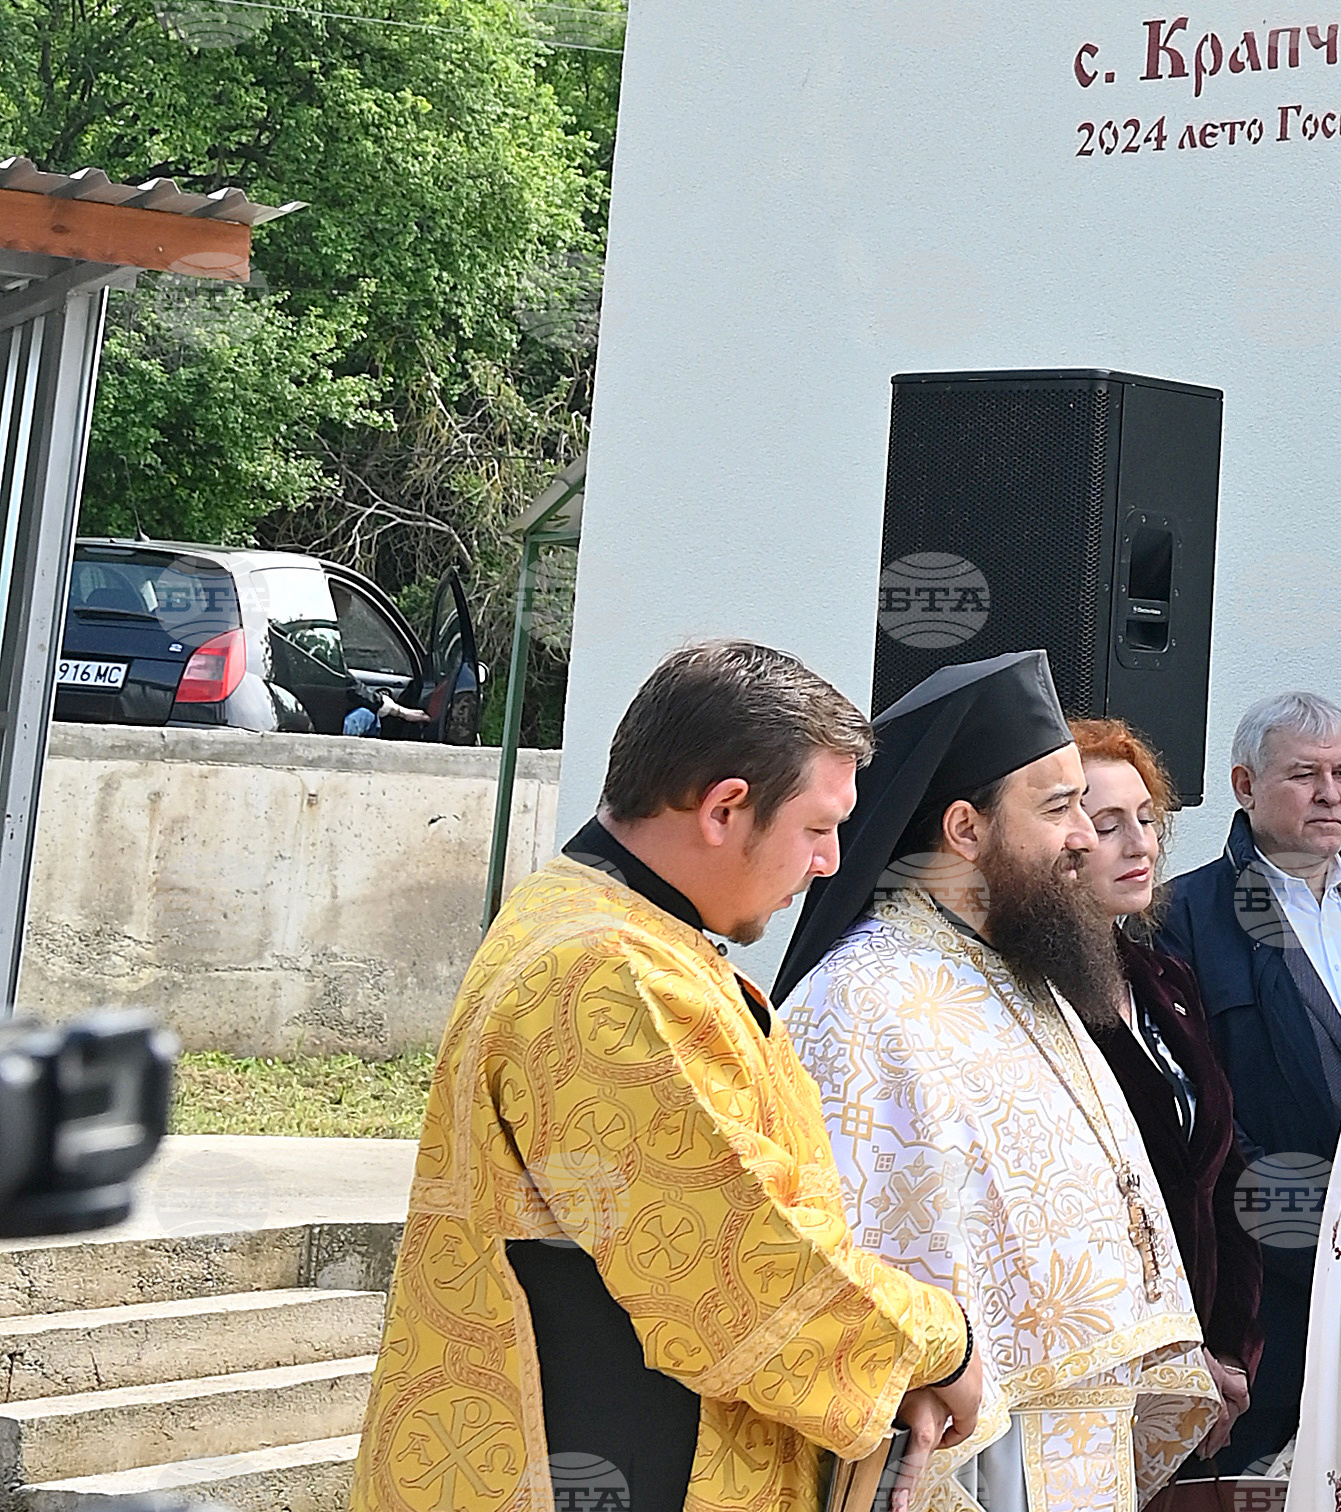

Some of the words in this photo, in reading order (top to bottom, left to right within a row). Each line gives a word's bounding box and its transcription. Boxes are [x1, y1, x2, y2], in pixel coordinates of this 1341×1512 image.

[1073, 43, 1116, 88] с.
[1075, 115, 1168, 157] 2024
[1177, 118, 1264, 150] лето
